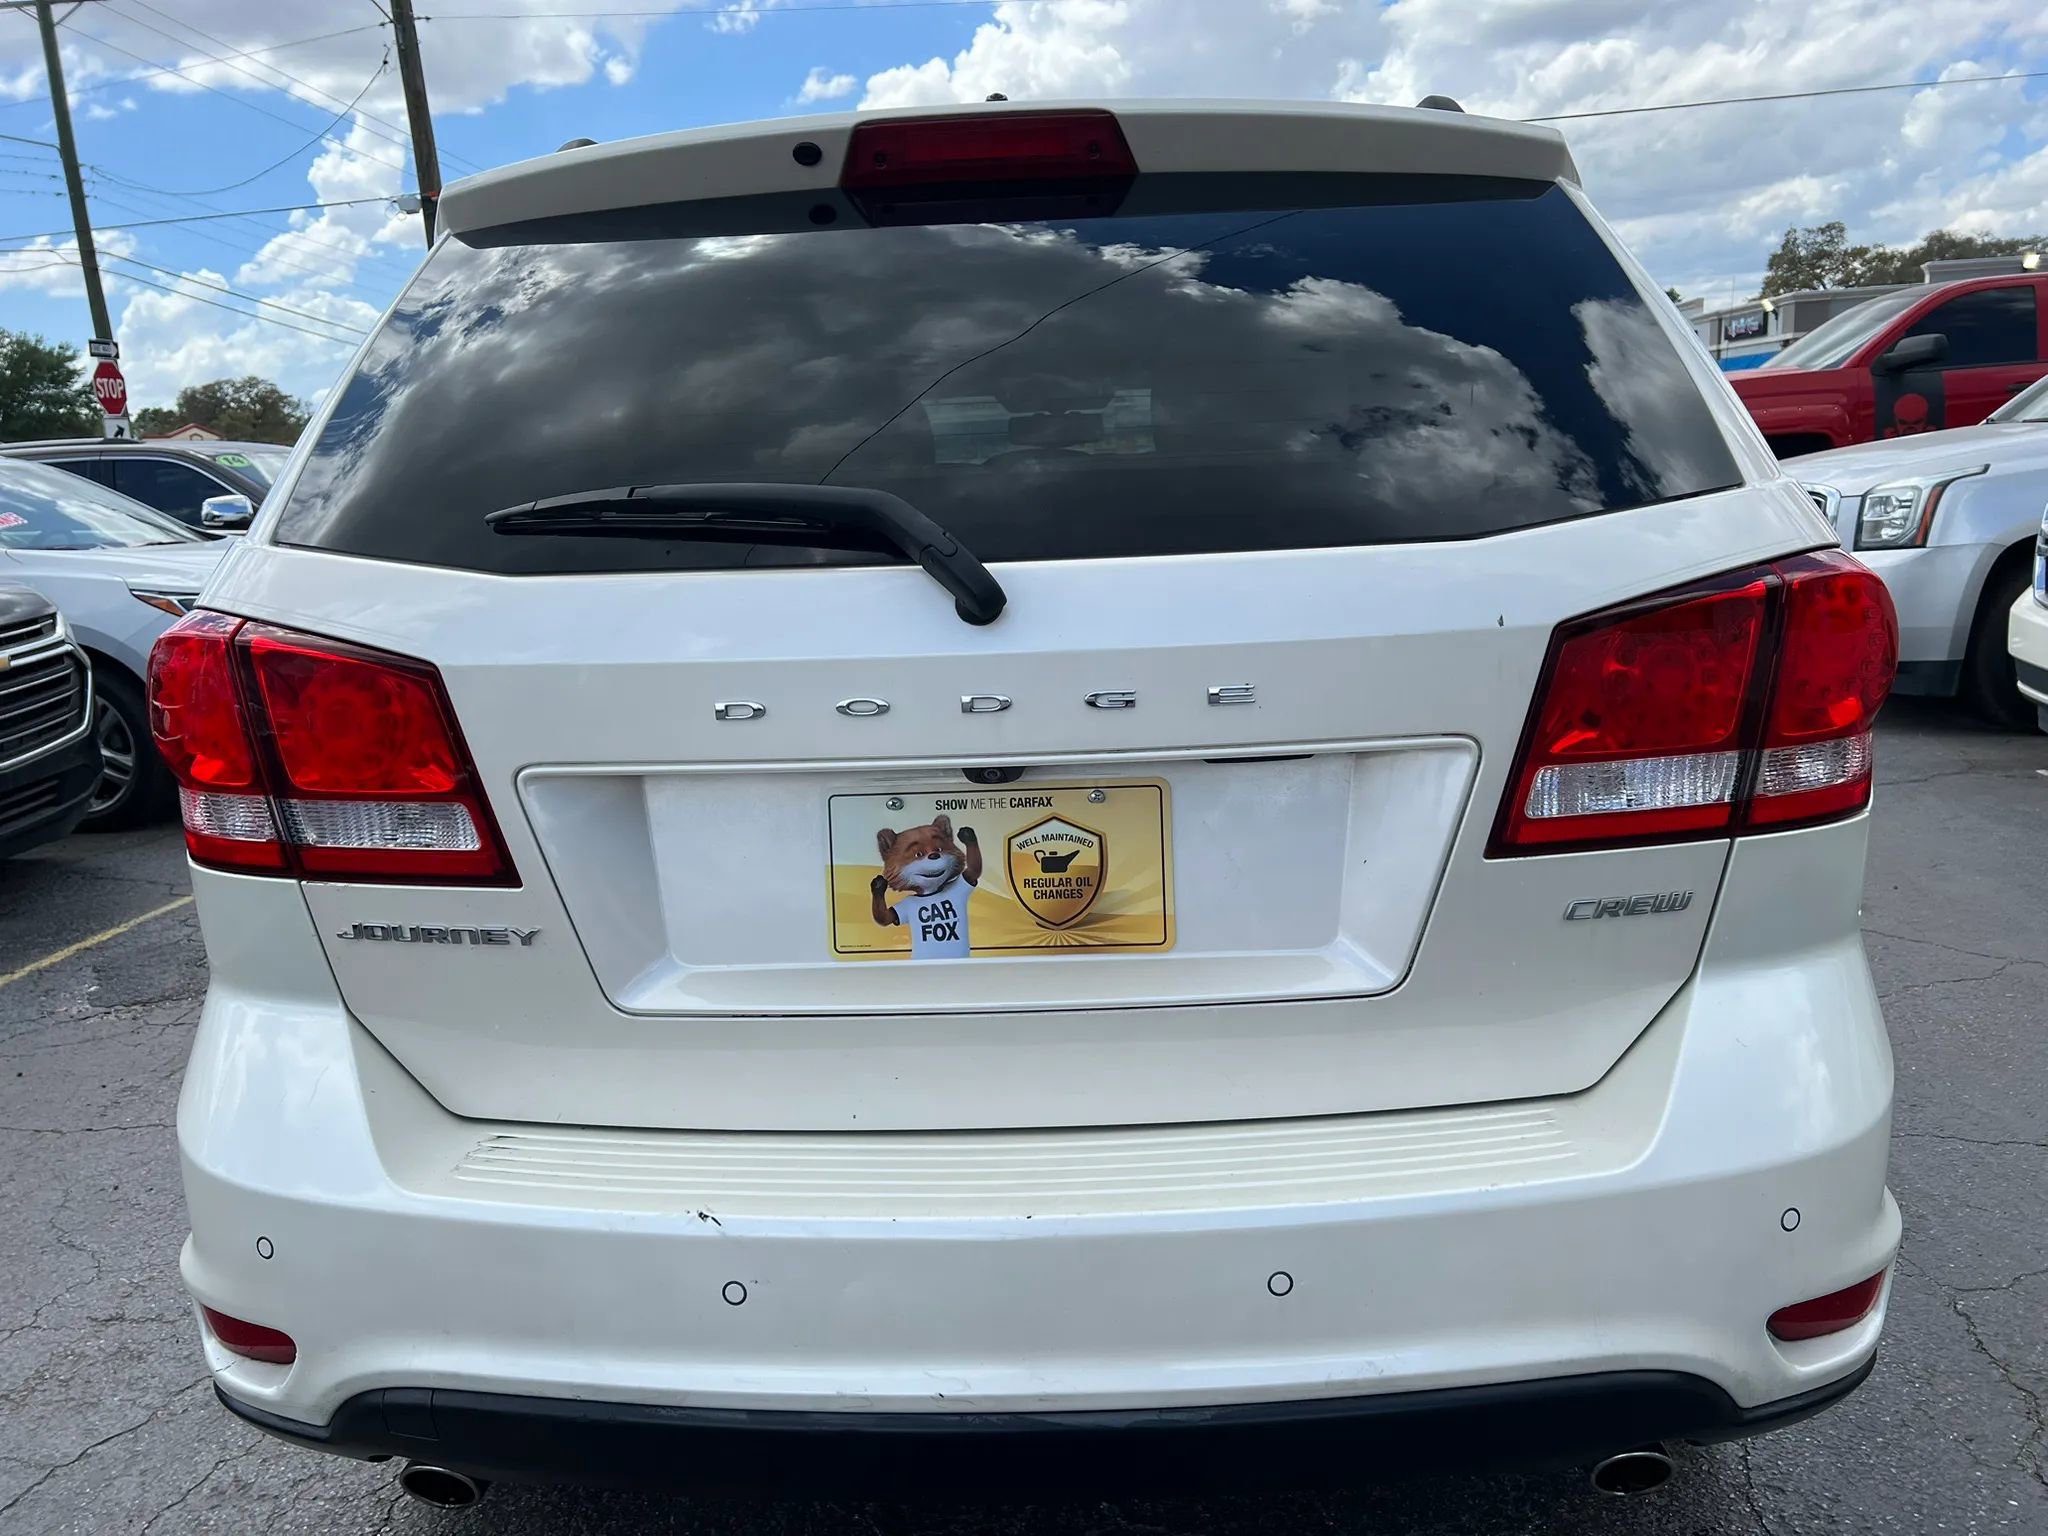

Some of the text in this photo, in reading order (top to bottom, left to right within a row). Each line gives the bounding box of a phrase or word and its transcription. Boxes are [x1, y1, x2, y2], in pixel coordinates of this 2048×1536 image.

[96, 377, 124, 399] STOP
[714, 682, 1256, 721] DODGE
[935, 796, 1053, 810] SHOW ME THE CARFAX
[1016, 833, 1094, 850] WELL MAINTAINED
[1023, 876, 1093, 888] REGULAR OIL
[1033, 888, 1084, 900] CHANGES
[917, 899, 958, 924] CAR
[1562, 889, 1694, 921] CREW
[336, 920, 541, 947] JOURNEY
[921, 922, 960, 943] FOX
